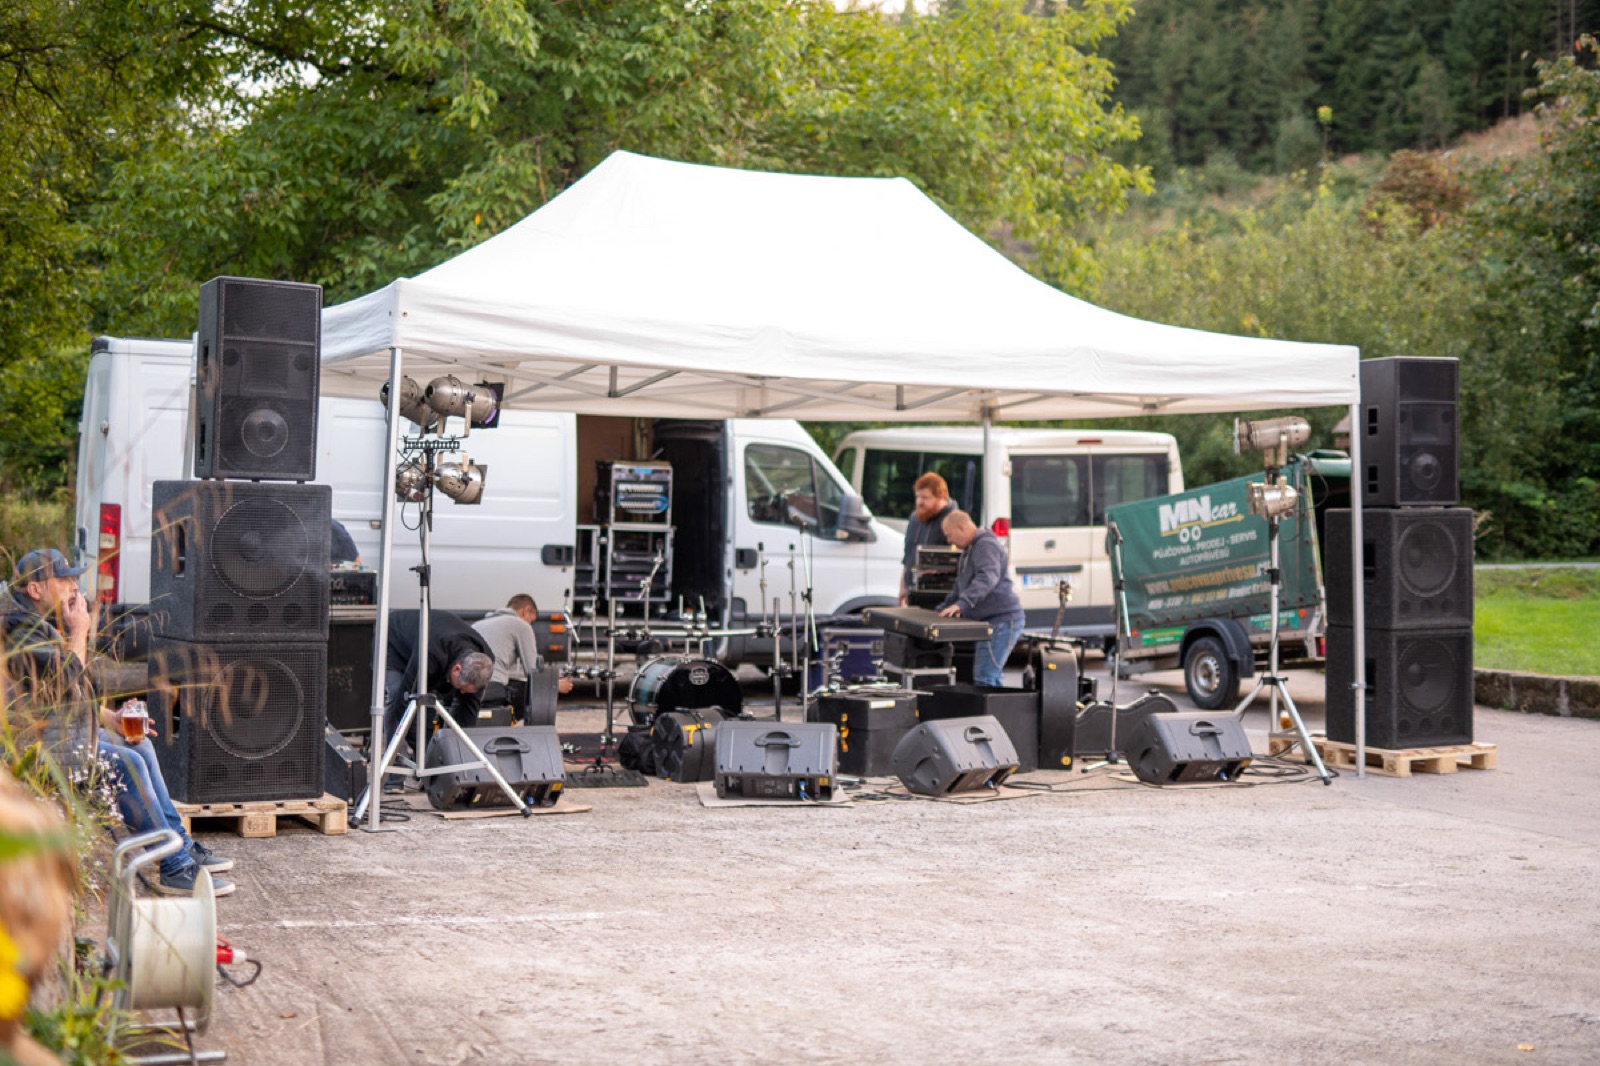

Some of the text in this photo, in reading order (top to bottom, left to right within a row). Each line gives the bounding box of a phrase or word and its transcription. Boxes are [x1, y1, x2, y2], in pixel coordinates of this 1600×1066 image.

[1159, 496, 1237, 533] MN car
[1196, 537, 1225, 553] PRODEJ
[1230, 530, 1257, 545] SERVIS
